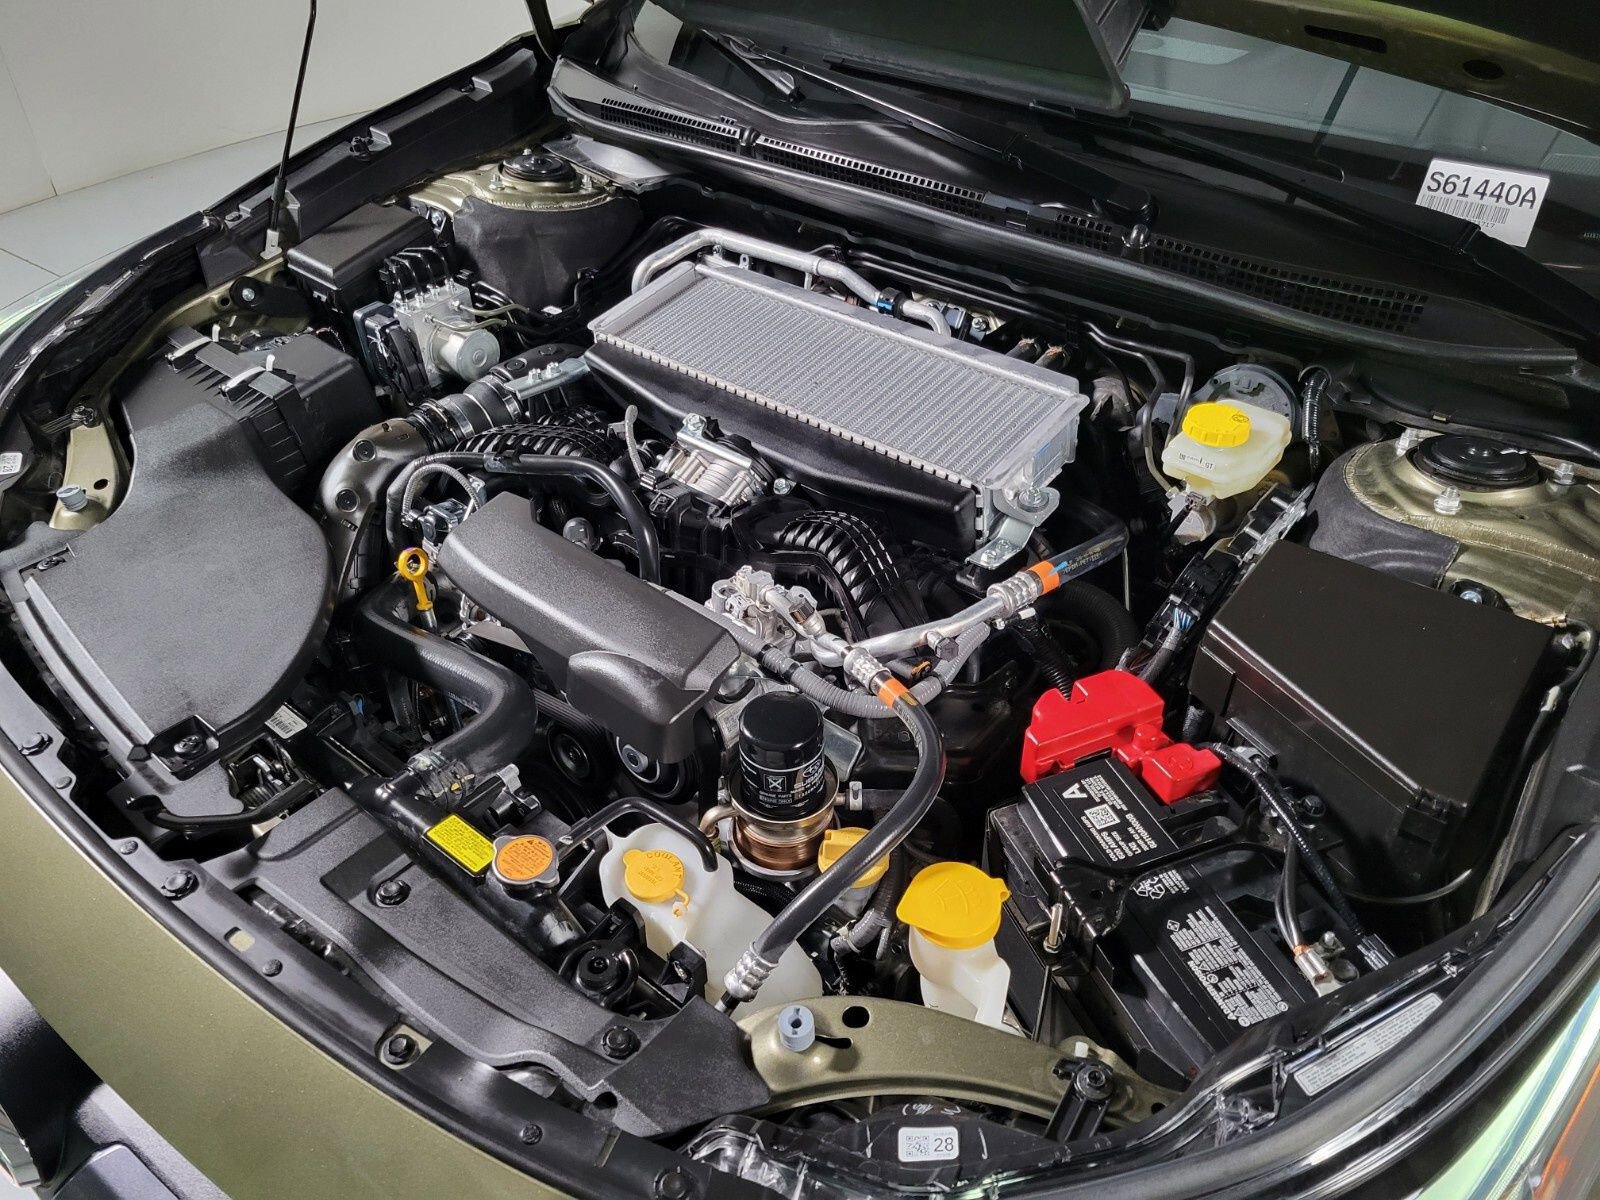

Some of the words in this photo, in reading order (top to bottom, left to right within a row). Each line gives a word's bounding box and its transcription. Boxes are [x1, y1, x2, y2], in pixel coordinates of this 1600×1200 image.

[1427, 171, 1537, 210] S61440A
[1062, 782, 1088, 798] A
[1100, 831, 1117, 849] AMPS
[934, 1136, 954, 1152] 28
